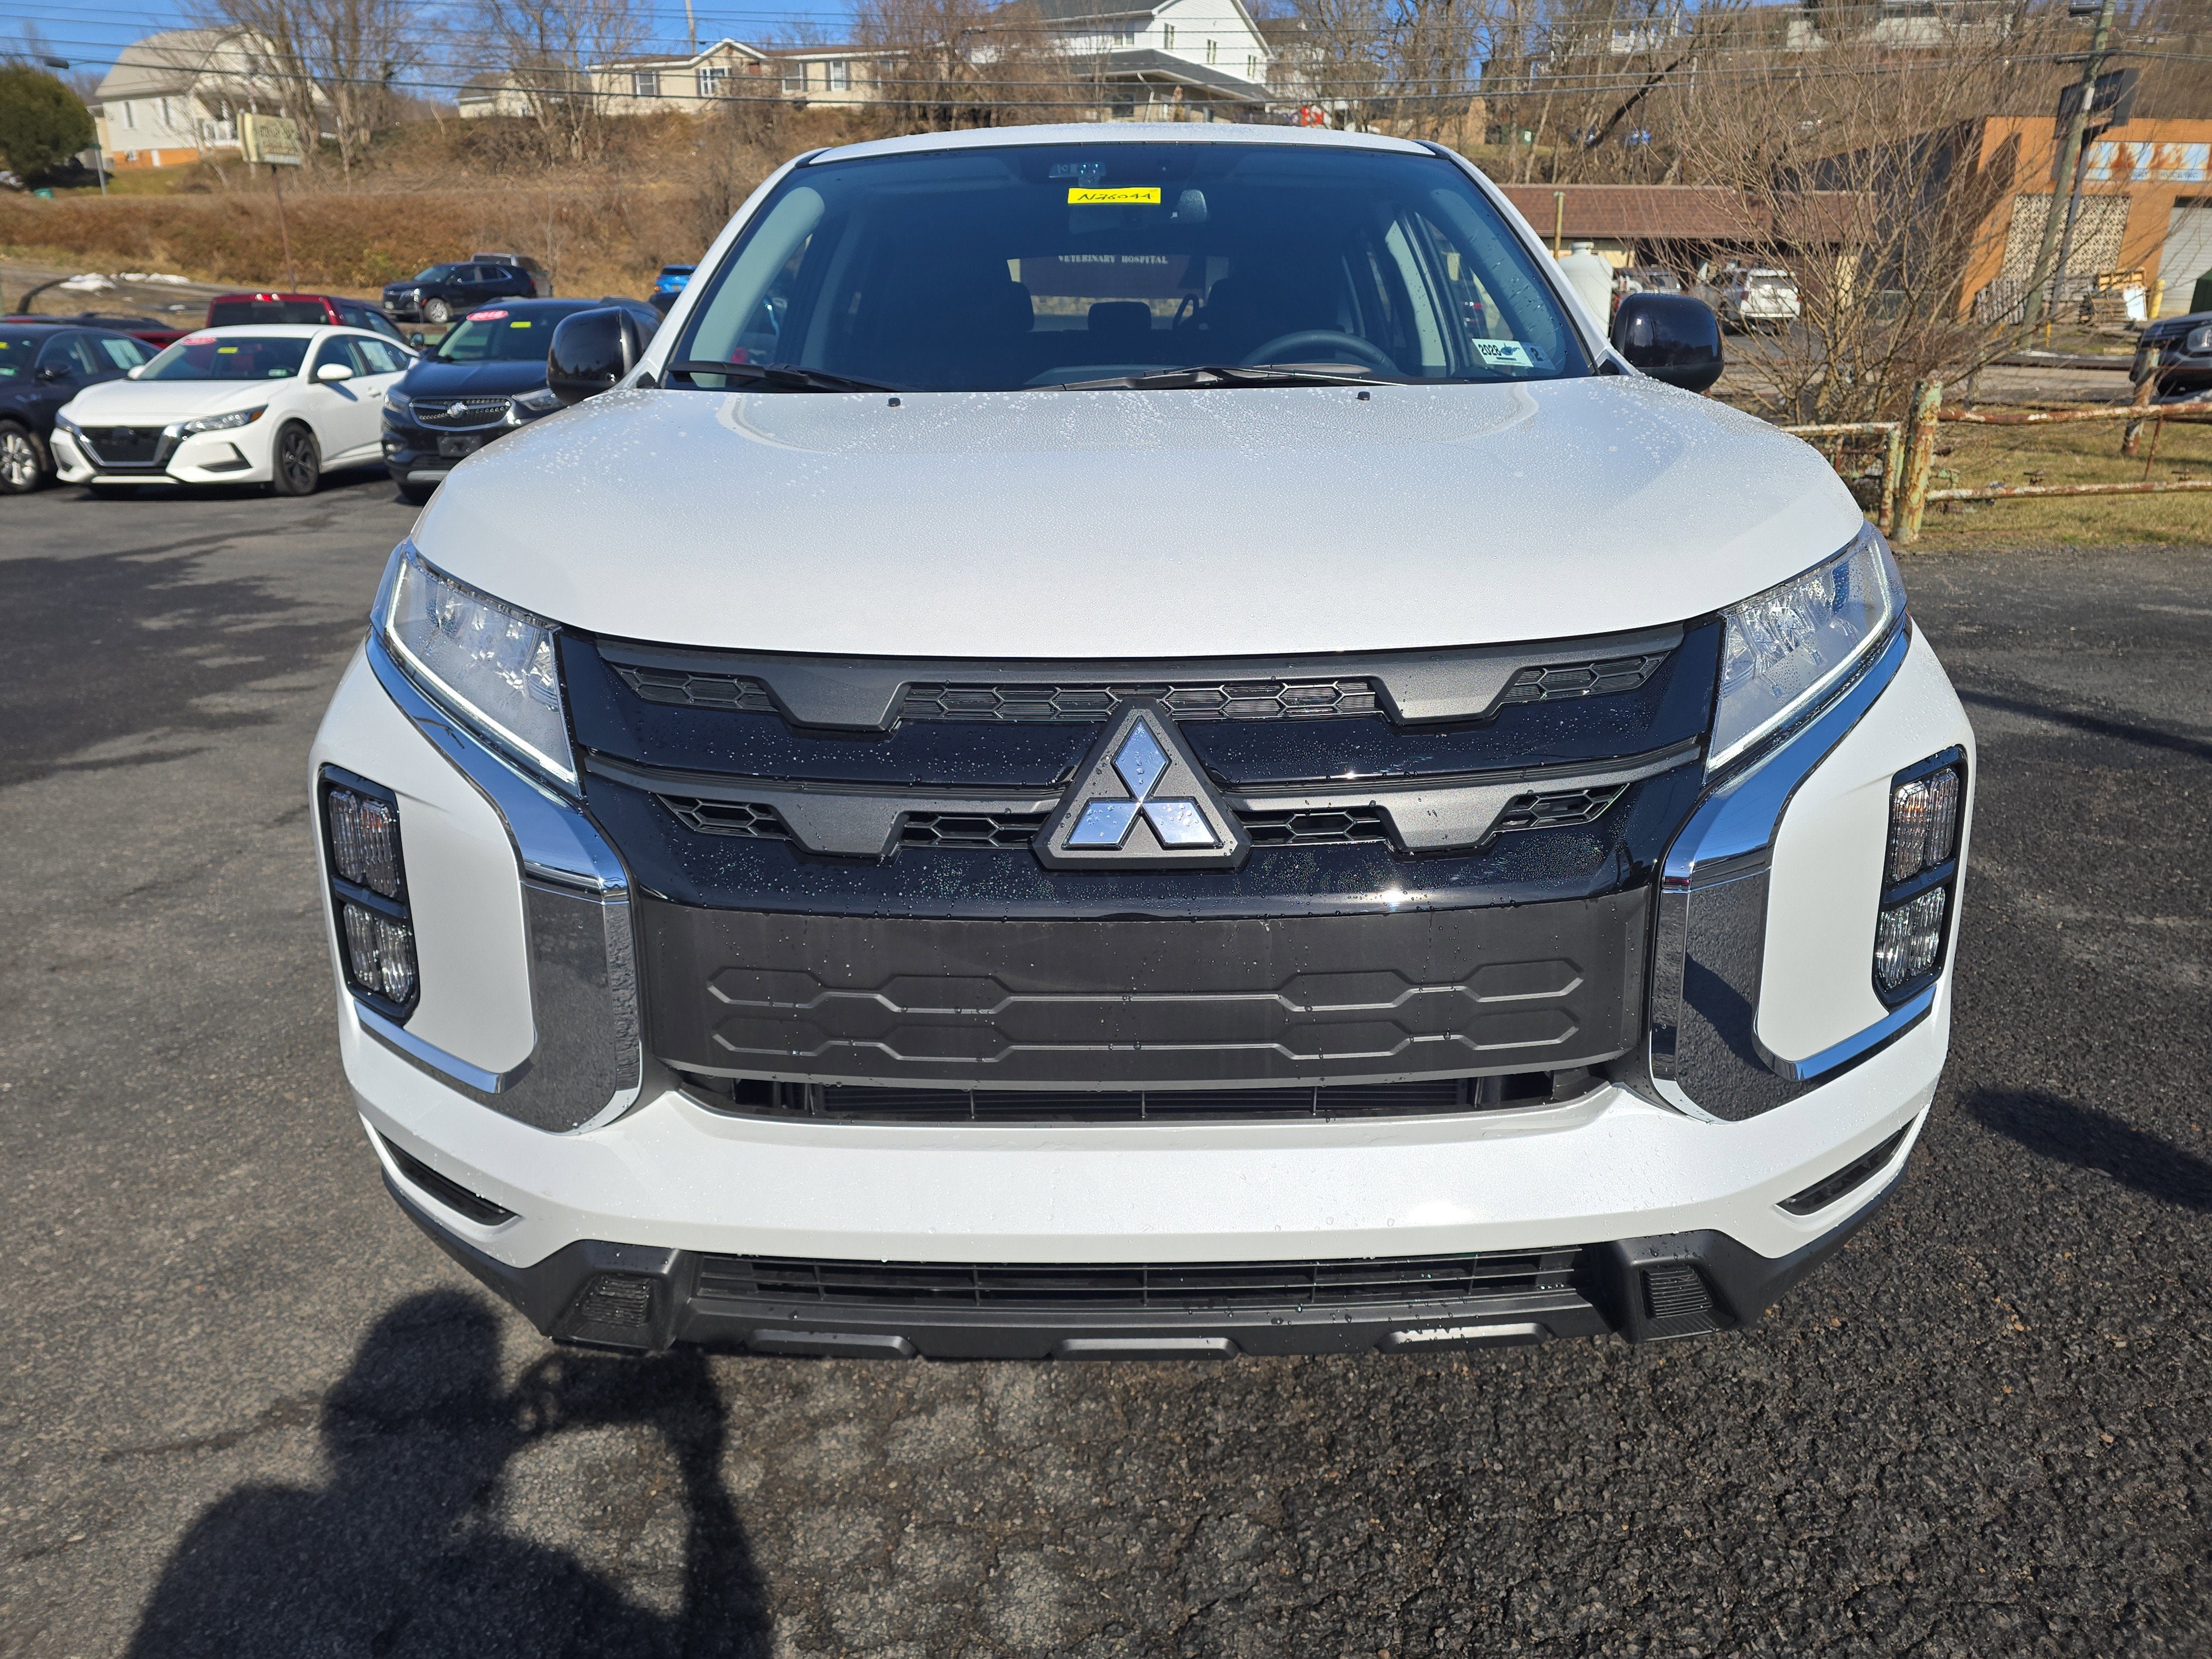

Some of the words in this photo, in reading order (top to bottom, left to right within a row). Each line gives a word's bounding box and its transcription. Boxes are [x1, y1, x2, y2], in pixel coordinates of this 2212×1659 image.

[1058, 254, 1115, 263] VETERINARY
[1121, 255, 1168, 264] HOSPITAL
[1478, 344, 1502, 356] 2028
[1531, 348, 1544, 361] 2
